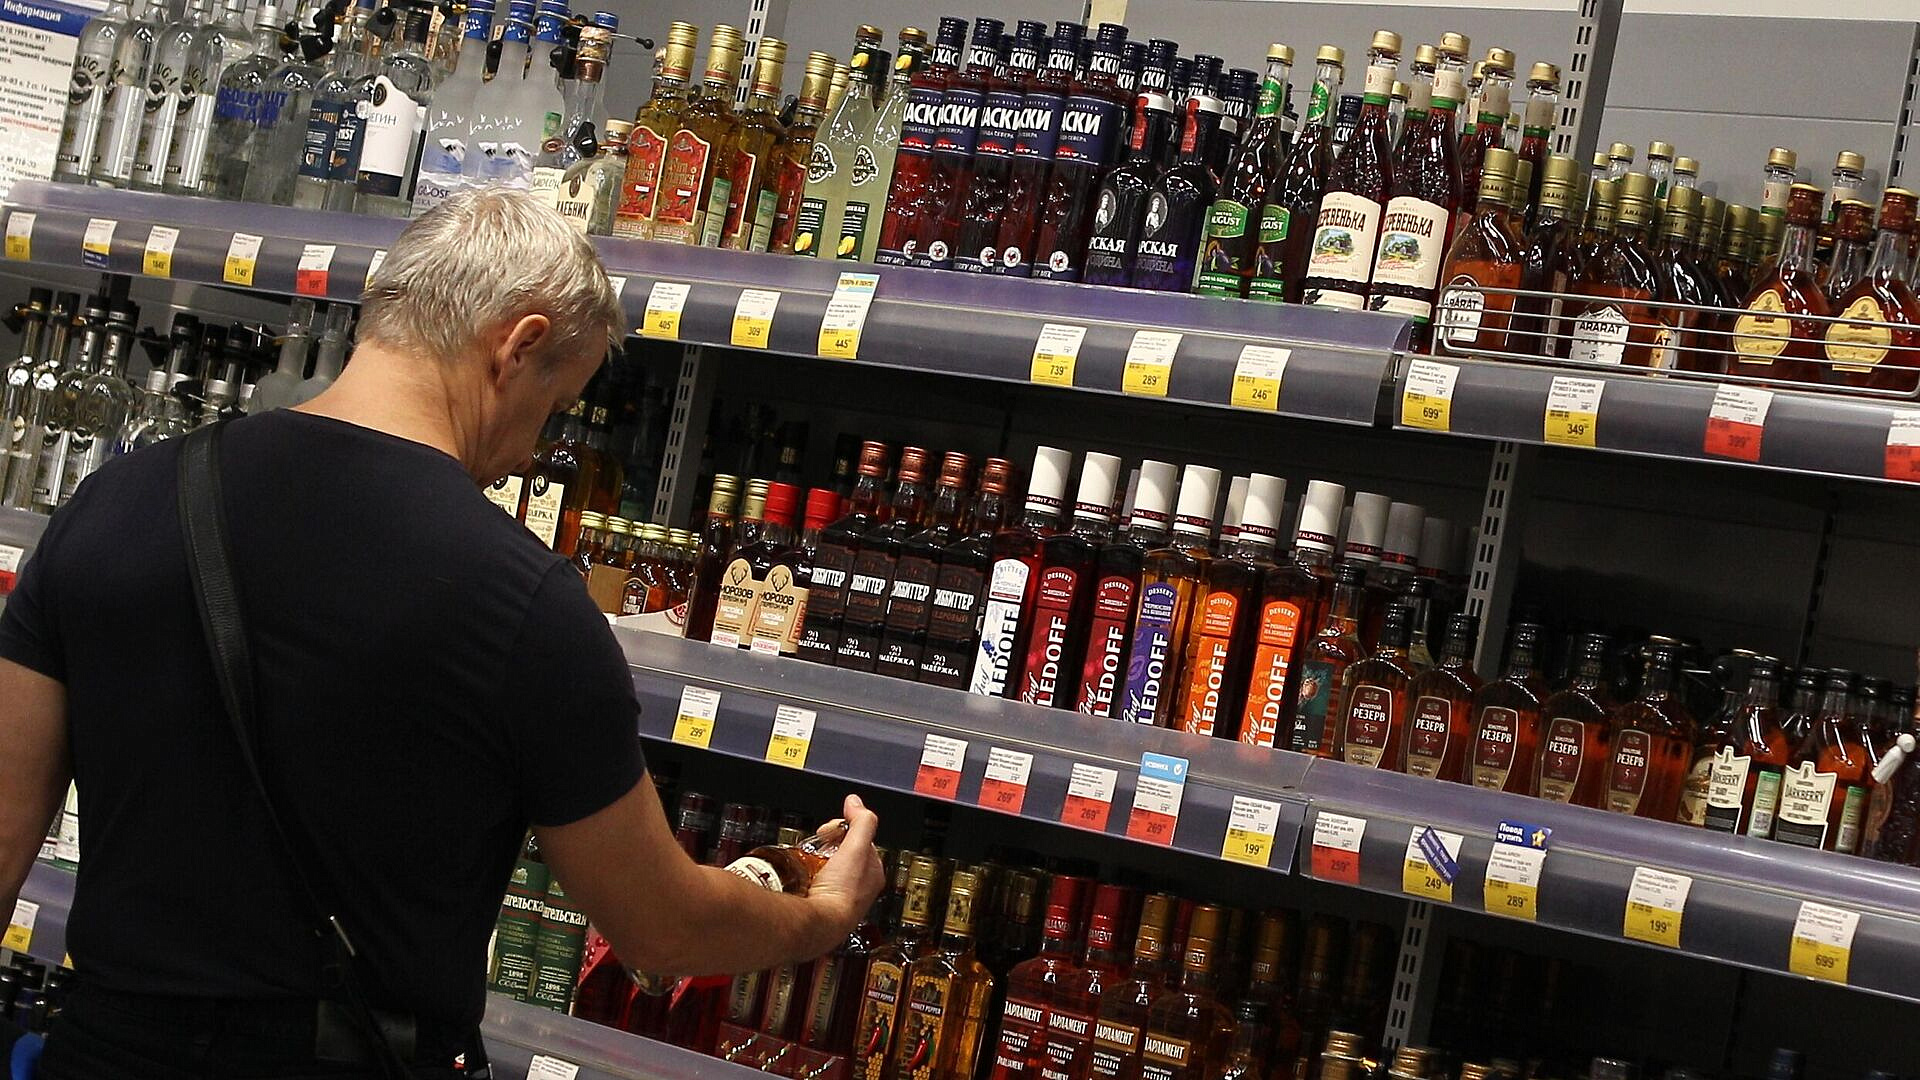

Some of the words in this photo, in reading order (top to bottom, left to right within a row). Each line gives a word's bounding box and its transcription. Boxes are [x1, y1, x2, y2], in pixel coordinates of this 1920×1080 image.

[4, 0, 61, 22] Информация
[659, 320, 671, 330] 405
[1579, 322, 1622, 334] ARARAT
[835, 339, 848, 349] 445
[1050, 365, 1063, 376] 739
[1143, 375, 1156, 385] 289
[1252, 388, 1267, 400] 246
[1423, 407, 1438, 419] 699
[1567, 423, 1584, 435] 349
[1081, 504, 1103, 512] SPIRIT
[1047, 572, 1073, 583] DESSERT
[1104, 581, 1130, 593] DESSERT
[1148, 587, 1174, 598] DESSERT
[1210, 597, 1233, 608] DESSERT
[1269, 607, 1296, 619] DESSERT
[990, 609, 1020, 697] LEDOFF
[1037, 616, 1067, 706] LEDOFF
[1094, 626, 1124, 718] LEDOFF
[1138, 633, 1168, 725] LEDOFF
[1200, 643, 1228, 736] LEDOFF
[1257, 653, 1289, 748] LEDOFF
[1353, 707, 1386, 722] РЕЗЕРВ
[690, 726, 704, 738] 299
[1415, 719, 1445, 733] РЕЗЕРВ
[1481, 729, 1512, 743] РЕЗЕРВ
[784, 747, 798, 758] 419
[1549, 741, 1578, 756] РЕЗЕРВ
[1616, 753, 1644, 767] РЕЗЕРВ
[1499, 823, 1524, 836] Повод
[1497, 833, 1523, 844] купить
[1245, 843, 1260, 855] 199
[1425, 876, 1441, 889] 249
[1507, 895, 1524, 908] 289
[1650, 920, 1667, 933] 199
[1816, 954, 1834, 968] 699
